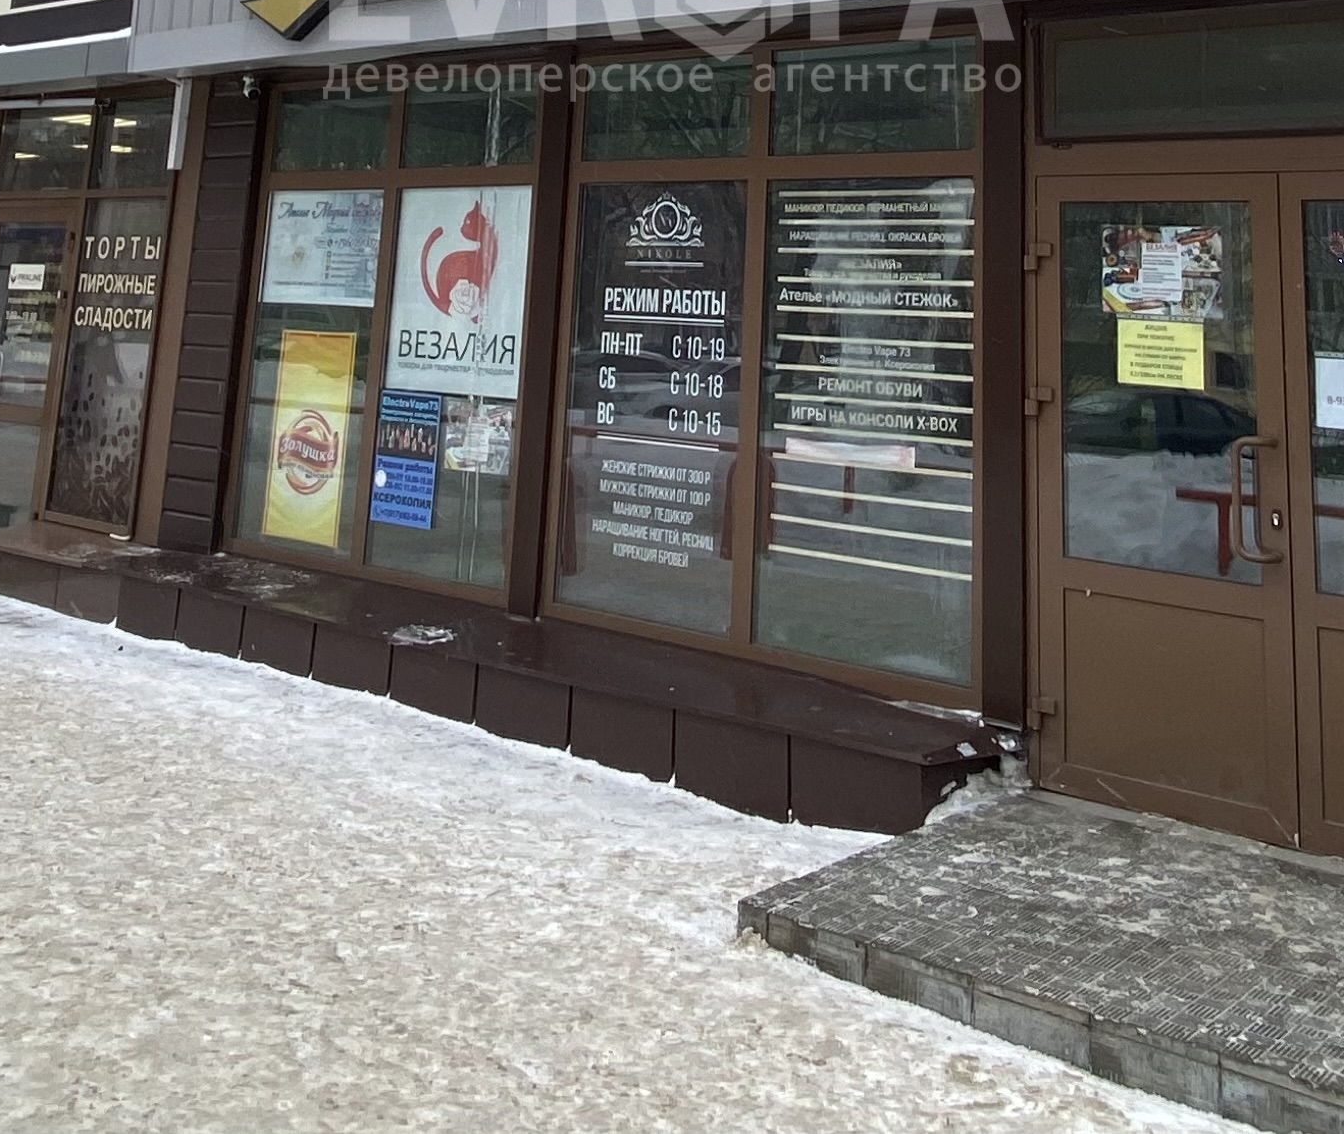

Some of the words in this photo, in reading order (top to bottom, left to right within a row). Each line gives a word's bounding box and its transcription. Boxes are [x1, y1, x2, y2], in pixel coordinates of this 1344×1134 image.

[84, 235, 162, 260] ТОРТЫ
[77, 272, 156, 295] ПИРОЖНЫЕ
[604, 287, 660, 314] РЕЖИМ
[662, 288, 727, 316] РАБОТЫ
[779, 287, 823, 304] Ателье
[894, 291, 959, 308] СТЕЖОК»
[74, 305, 153, 333] СЛАДОСТИ
[397, 328, 517, 366] ВЕЗАЛИЯ
[600, 330, 644, 356] ПН-ПТ
[672, 334, 683, 359] С
[686, 336, 726, 362] 10-19
[898, 346, 911, 358] 73
[598, 366, 617, 390] СБ
[670, 371, 681, 395] С
[684, 373, 724, 399] 10-18
[818, 377, 873, 393] РЕМОНТ
[875, 383, 923, 398] ОБУВИ
[596, 401, 615, 425] ВС
[668, 408, 678, 431] С
[682, 409, 722, 436] 10-15
[791, 405, 827, 422] ИГРЫ
[828, 409, 847, 423] НА
[848, 411, 914, 430] КОНСОЛИ
[916, 415, 959, 433] X-BOX
[279, 437, 336, 463] Золушка
[676, 470, 687, 482] ОТ
[372, 492, 432, 510] КСЕРОКОПИЯ
[676, 491, 687, 503] ОТ
